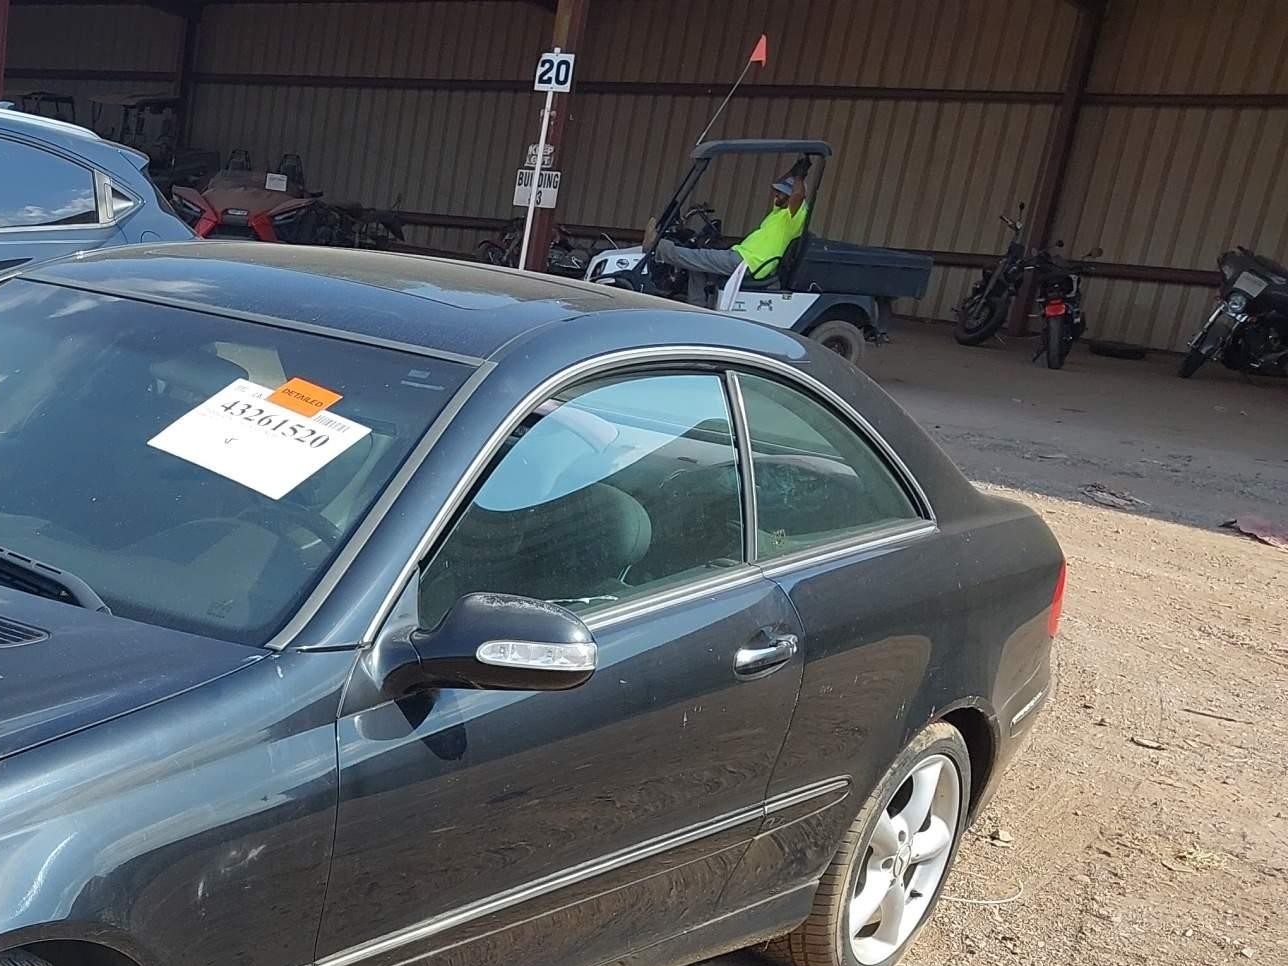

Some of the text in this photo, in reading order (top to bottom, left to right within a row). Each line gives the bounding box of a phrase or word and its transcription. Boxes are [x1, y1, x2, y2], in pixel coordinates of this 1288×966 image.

[537, 58, 571, 85] 20
[517, 171, 559, 189] BUIDING
[281, 387, 324, 408] DETAILED
[220, 399, 330, 449] 43261520
